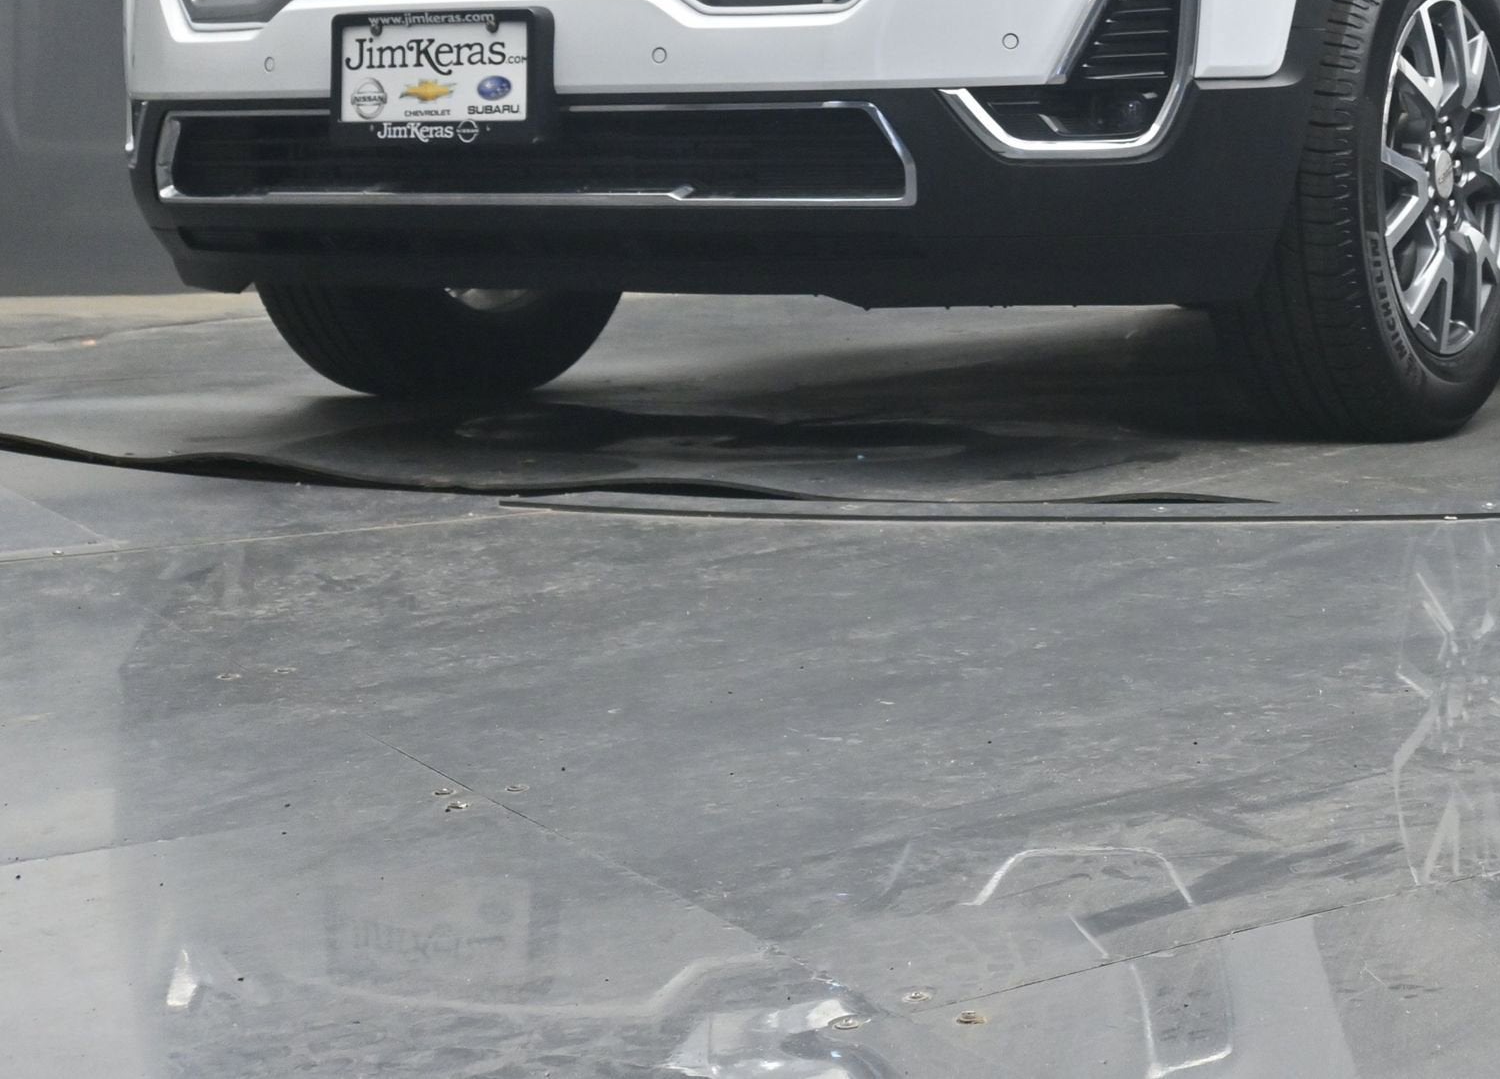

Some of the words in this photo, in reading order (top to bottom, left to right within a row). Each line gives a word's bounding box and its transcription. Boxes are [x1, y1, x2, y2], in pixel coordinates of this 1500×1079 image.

[368, 12, 495, 27] www.jimkeras.com
[354, 94, 384, 103] NISSAN
[404, 109, 451, 117] CHEVROLET
[467, 104, 520, 115] SUBARU
[1369, 237, 1408, 360] MICHELIN
